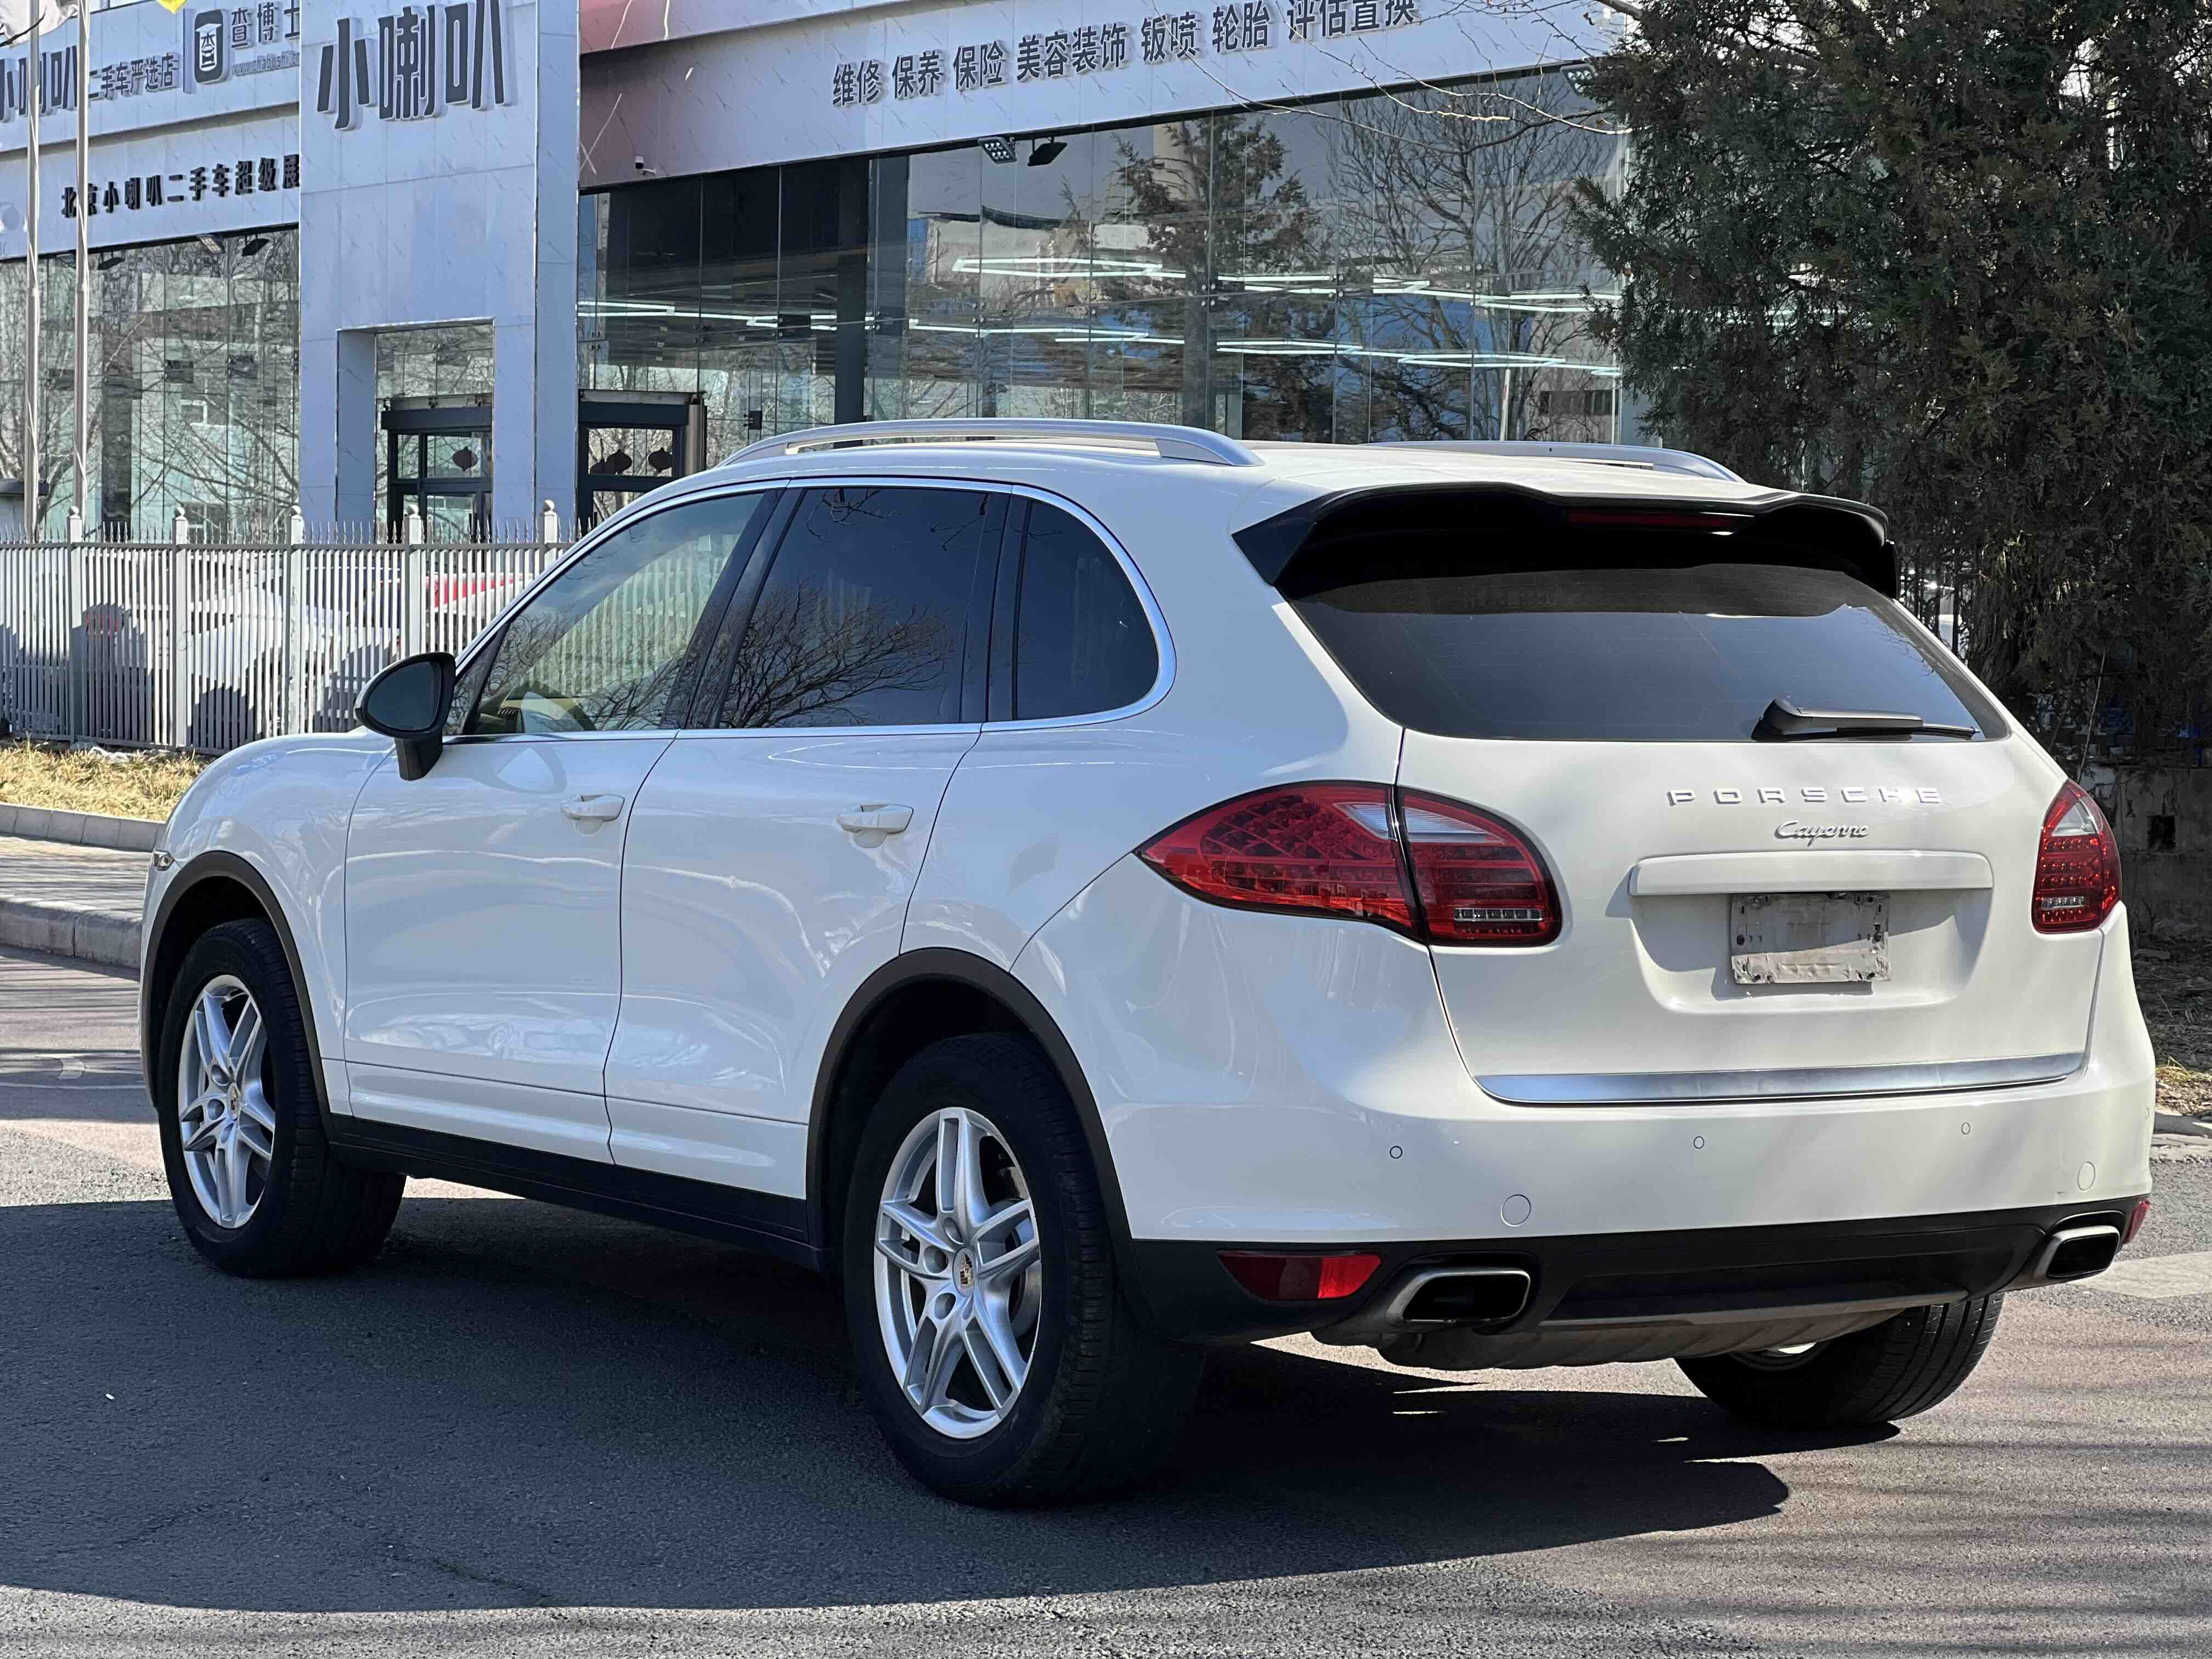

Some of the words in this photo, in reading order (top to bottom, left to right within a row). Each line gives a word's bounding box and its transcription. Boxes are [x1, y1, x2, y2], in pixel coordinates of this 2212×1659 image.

[231, 0, 300, 48] 查博士
[316, 0, 504, 129] 小喇叭
[833, 60, 879, 105] 维修
[891, 50, 944, 99] 保养
[953, 41, 1003, 90] 保险
[1017, 23, 1125, 81] 美容装饰
[1141, 11, 1197, 62] 钣喷
[1212, 0, 1271, 53] 轮胎
[1666, 787, 1941, 806] PORSCHE
[1773, 820, 1870, 847] Cayenne
